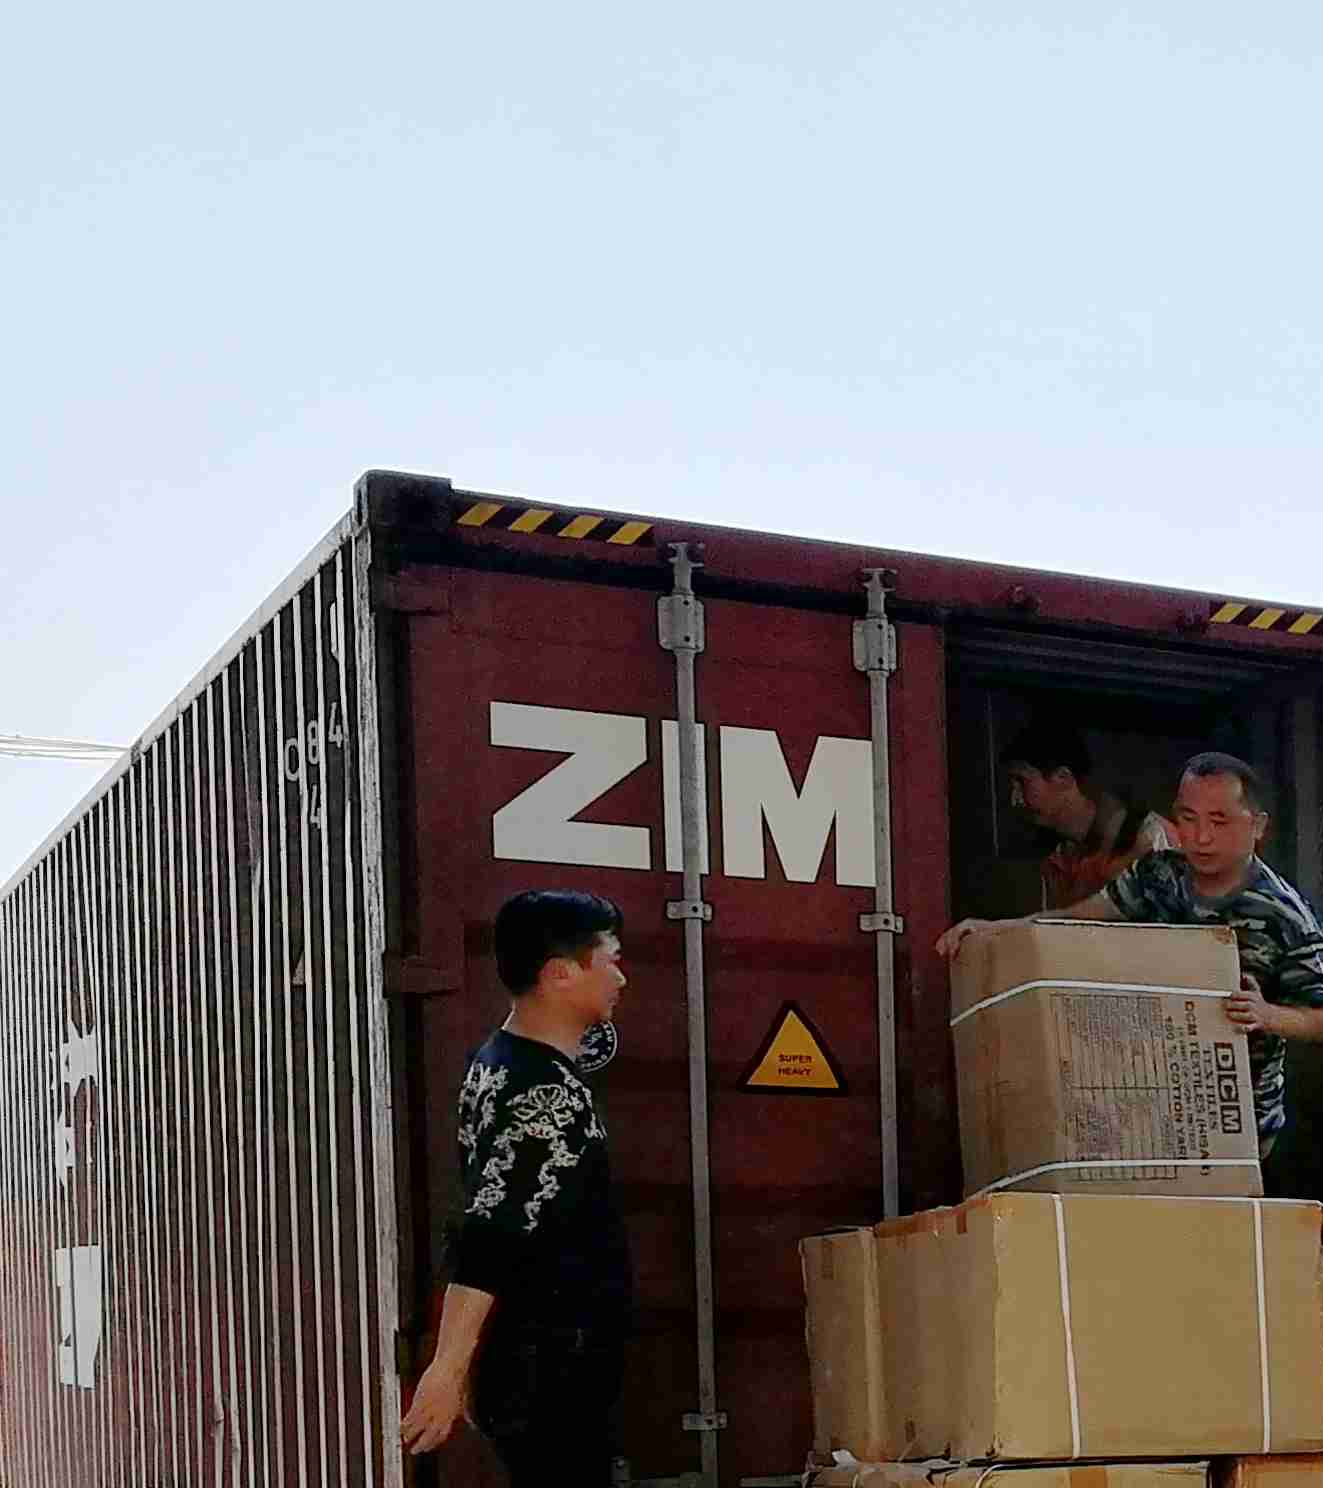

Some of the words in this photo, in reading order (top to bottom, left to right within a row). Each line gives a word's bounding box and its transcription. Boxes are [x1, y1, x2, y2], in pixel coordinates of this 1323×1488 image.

[489, 701, 877, 888] ZIM
[1170, 1062, 1184, 1123] COTTON
[1189, 1041, 1206, 1114] TEXTILES
[1214, 1042, 1242, 1134] DCM
